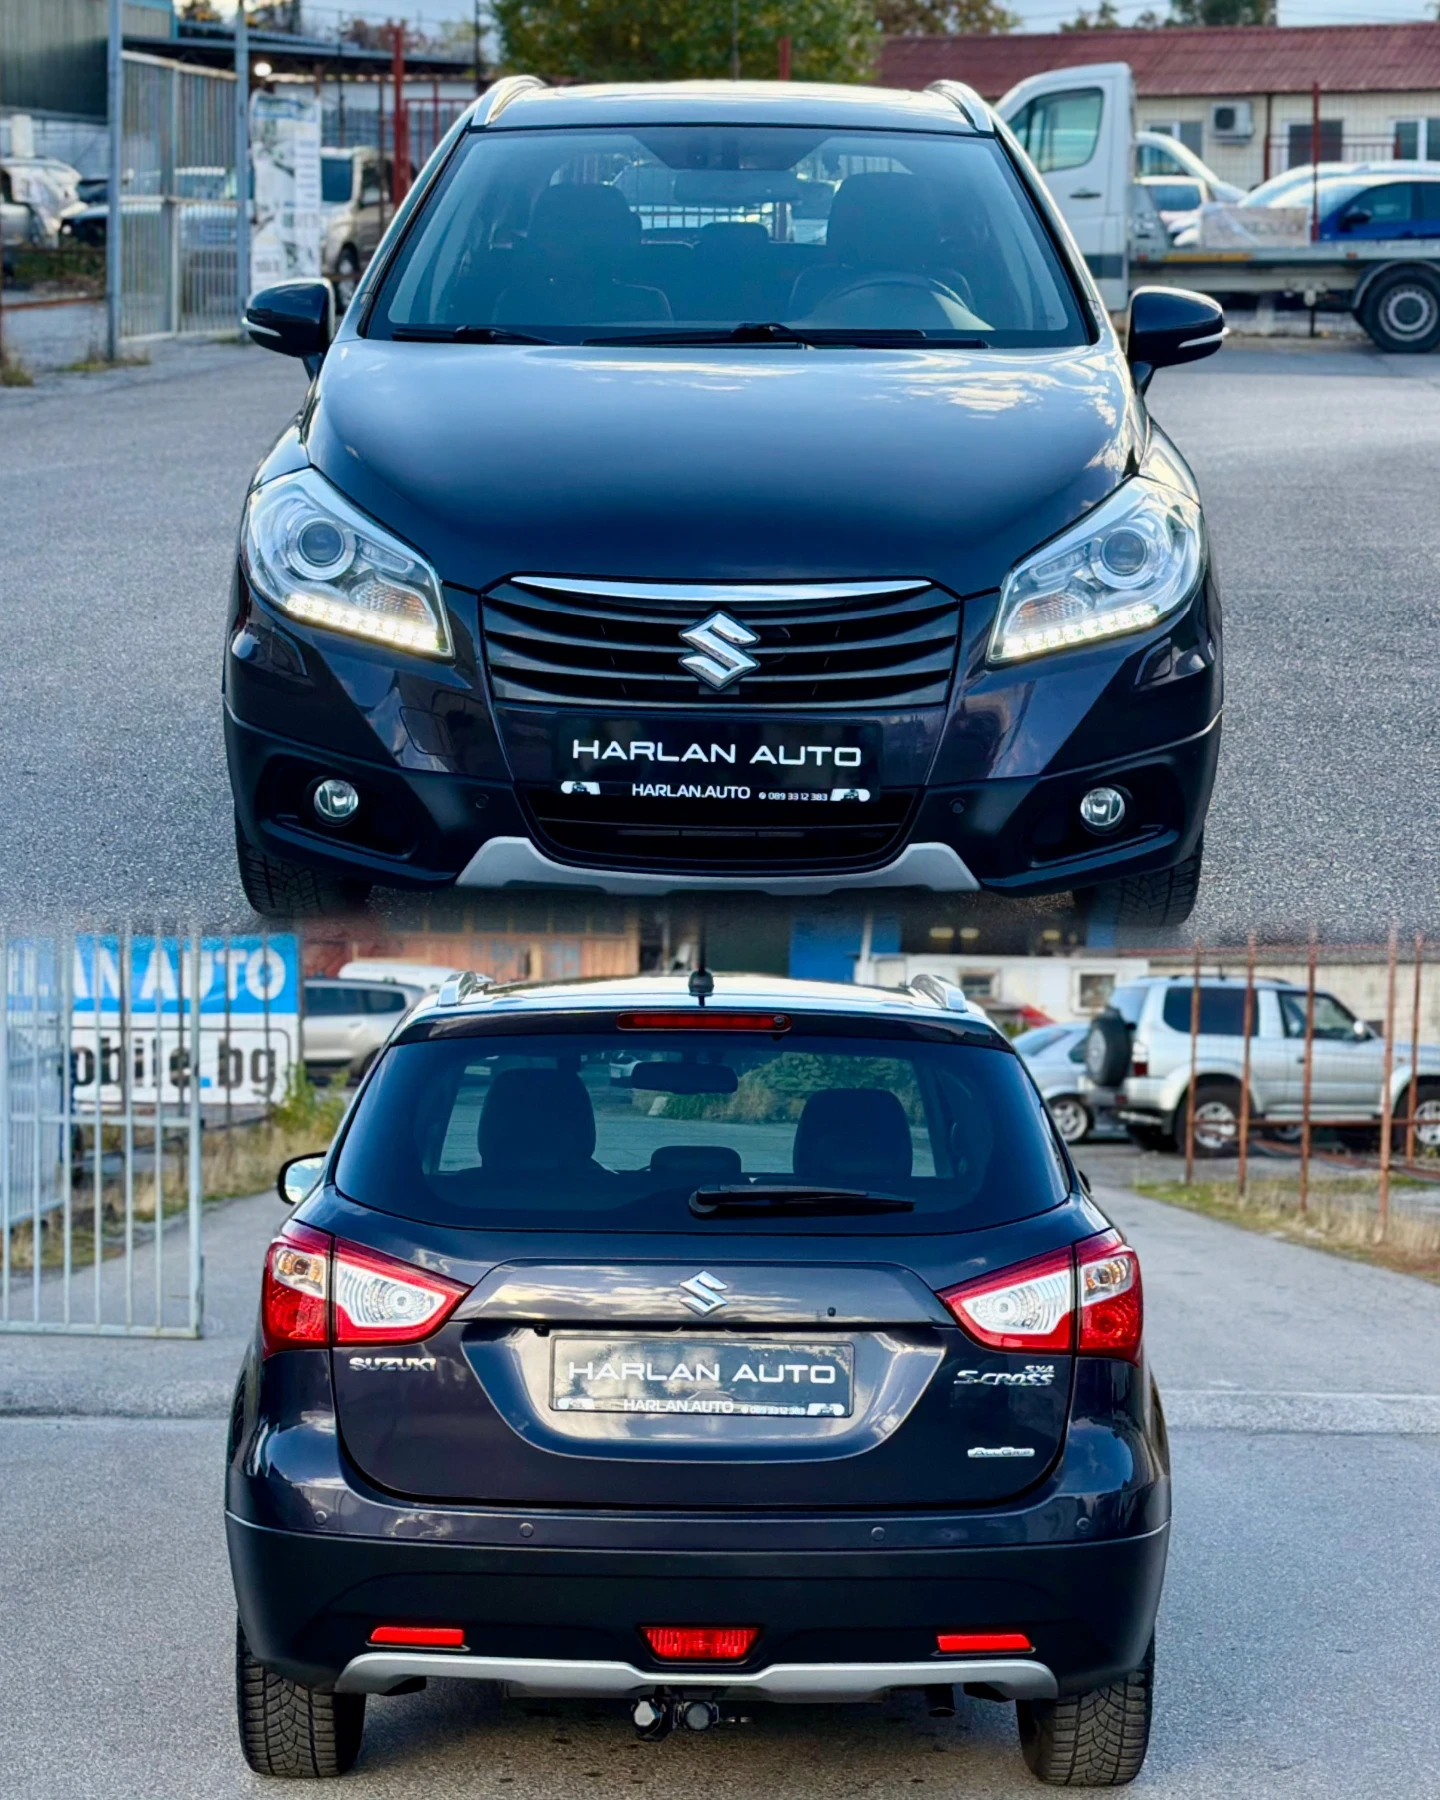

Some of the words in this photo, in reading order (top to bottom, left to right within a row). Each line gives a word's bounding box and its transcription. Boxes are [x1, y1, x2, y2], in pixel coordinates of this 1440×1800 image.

[572, 739, 736, 764] HARLAN
[749, 745, 862, 767] AUTO
[632, 783, 750, 799] HARLAN.AUTO
[139, 947, 286, 1001] AUTO
[349, 1357, 437, 1371] SUZUKI
[568, 1361, 720, 1382] HARLAN
[732, 1363, 836, 1384] AUTO
